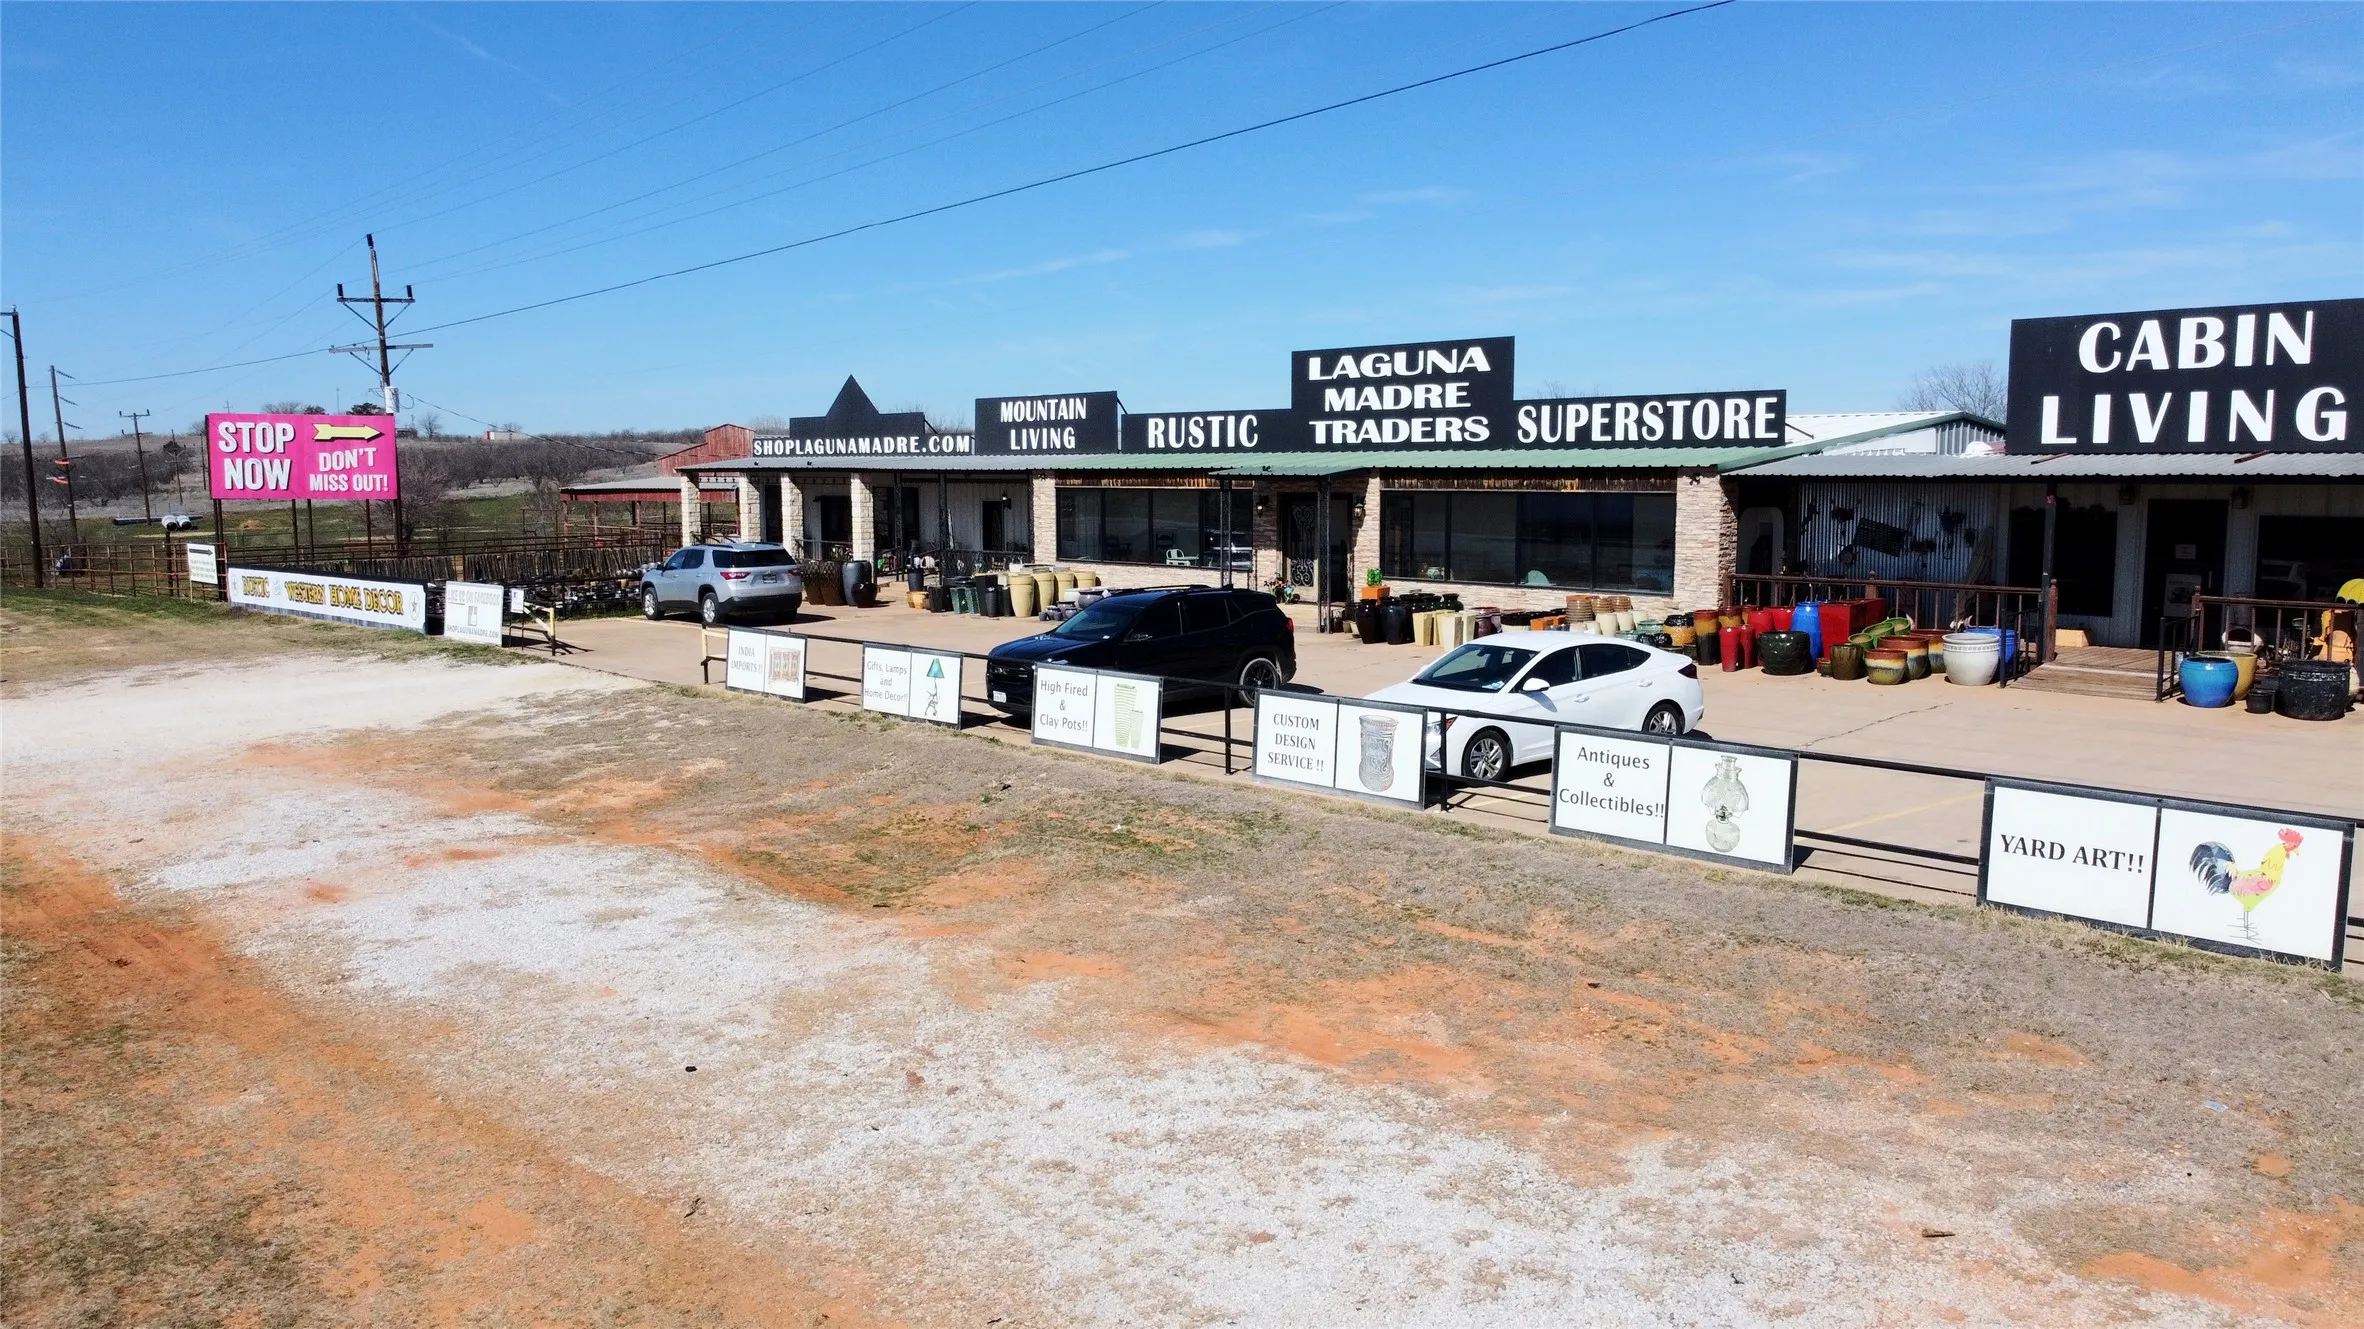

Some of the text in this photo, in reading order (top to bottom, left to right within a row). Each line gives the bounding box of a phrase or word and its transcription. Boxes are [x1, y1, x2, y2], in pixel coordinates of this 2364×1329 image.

[2079, 310, 2314, 373] CABIN
[1308, 347, 1491, 381] LAGUNA
[1324, 382, 1471, 412] MADRE
[1000, 398, 1087, 422] MOUNTAIN
[1517, 397, 1778, 443] SUPERSTORE
[2040, 387, 2347, 444] LIVING
[218, 421, 296, 454] STOP
[1010, 427, 1076, 450] LIVING
[1148, 414, 1259, 449] RUSTIC
[1308, 416, 1490, 444] TRADERS
[753, 435, 970, 456] SHOPLAGUNAMADRE.COM
[319, 447, 377, 472] DON'T
[223, 457, 292, 491] NOW
[309, 473, 389, 492] MISS OUT!
[284, 580, 326, 606] WESTERN
[328, 584, 363, 610] HOME
[363, 588, 404, 615] DECOR
[448, 588, 458, 601] LIKE
[474, 592, 500, 606] FACEBOOK
[738, 645, 756, 657] INDIA
[730, 659, 757, 673] IMPORTS
[866, 660, 907, 675] Gifts, Lamps
[879, 675, 893, 688] and
[1040, 679, 1089, 697] High Fired
[864, 689, 908, 702] Home Decor!!
[1059, 699, 1066, 711] &
[1039, 713, 1089, 732] Clay Pots!!
[1273, 712, 1320, 731] CUSTOM
[1274, 732, 1317, 751] DESIGN
[1267, 750, 1325, 773] SERVICE !!
[1577, 747, 1650, 769] Antiques
[1603, 772, 1615, 787] &
[1559, 788, 1664, 818] Collectibles!!
[2000, 834, 2144, 874] YARD ART!!
